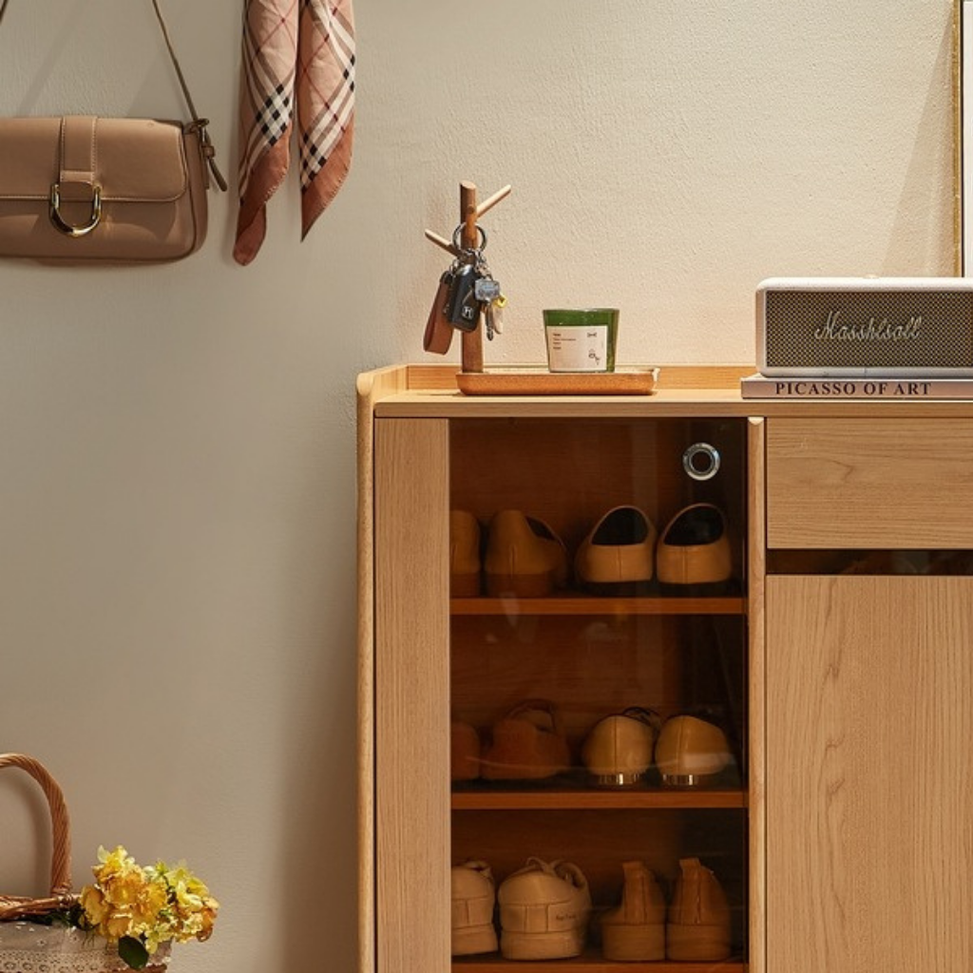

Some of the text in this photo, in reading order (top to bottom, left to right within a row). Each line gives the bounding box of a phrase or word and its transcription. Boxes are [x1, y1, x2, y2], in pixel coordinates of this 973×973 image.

[776, 382, 932, 395] PICASSO OF ART
